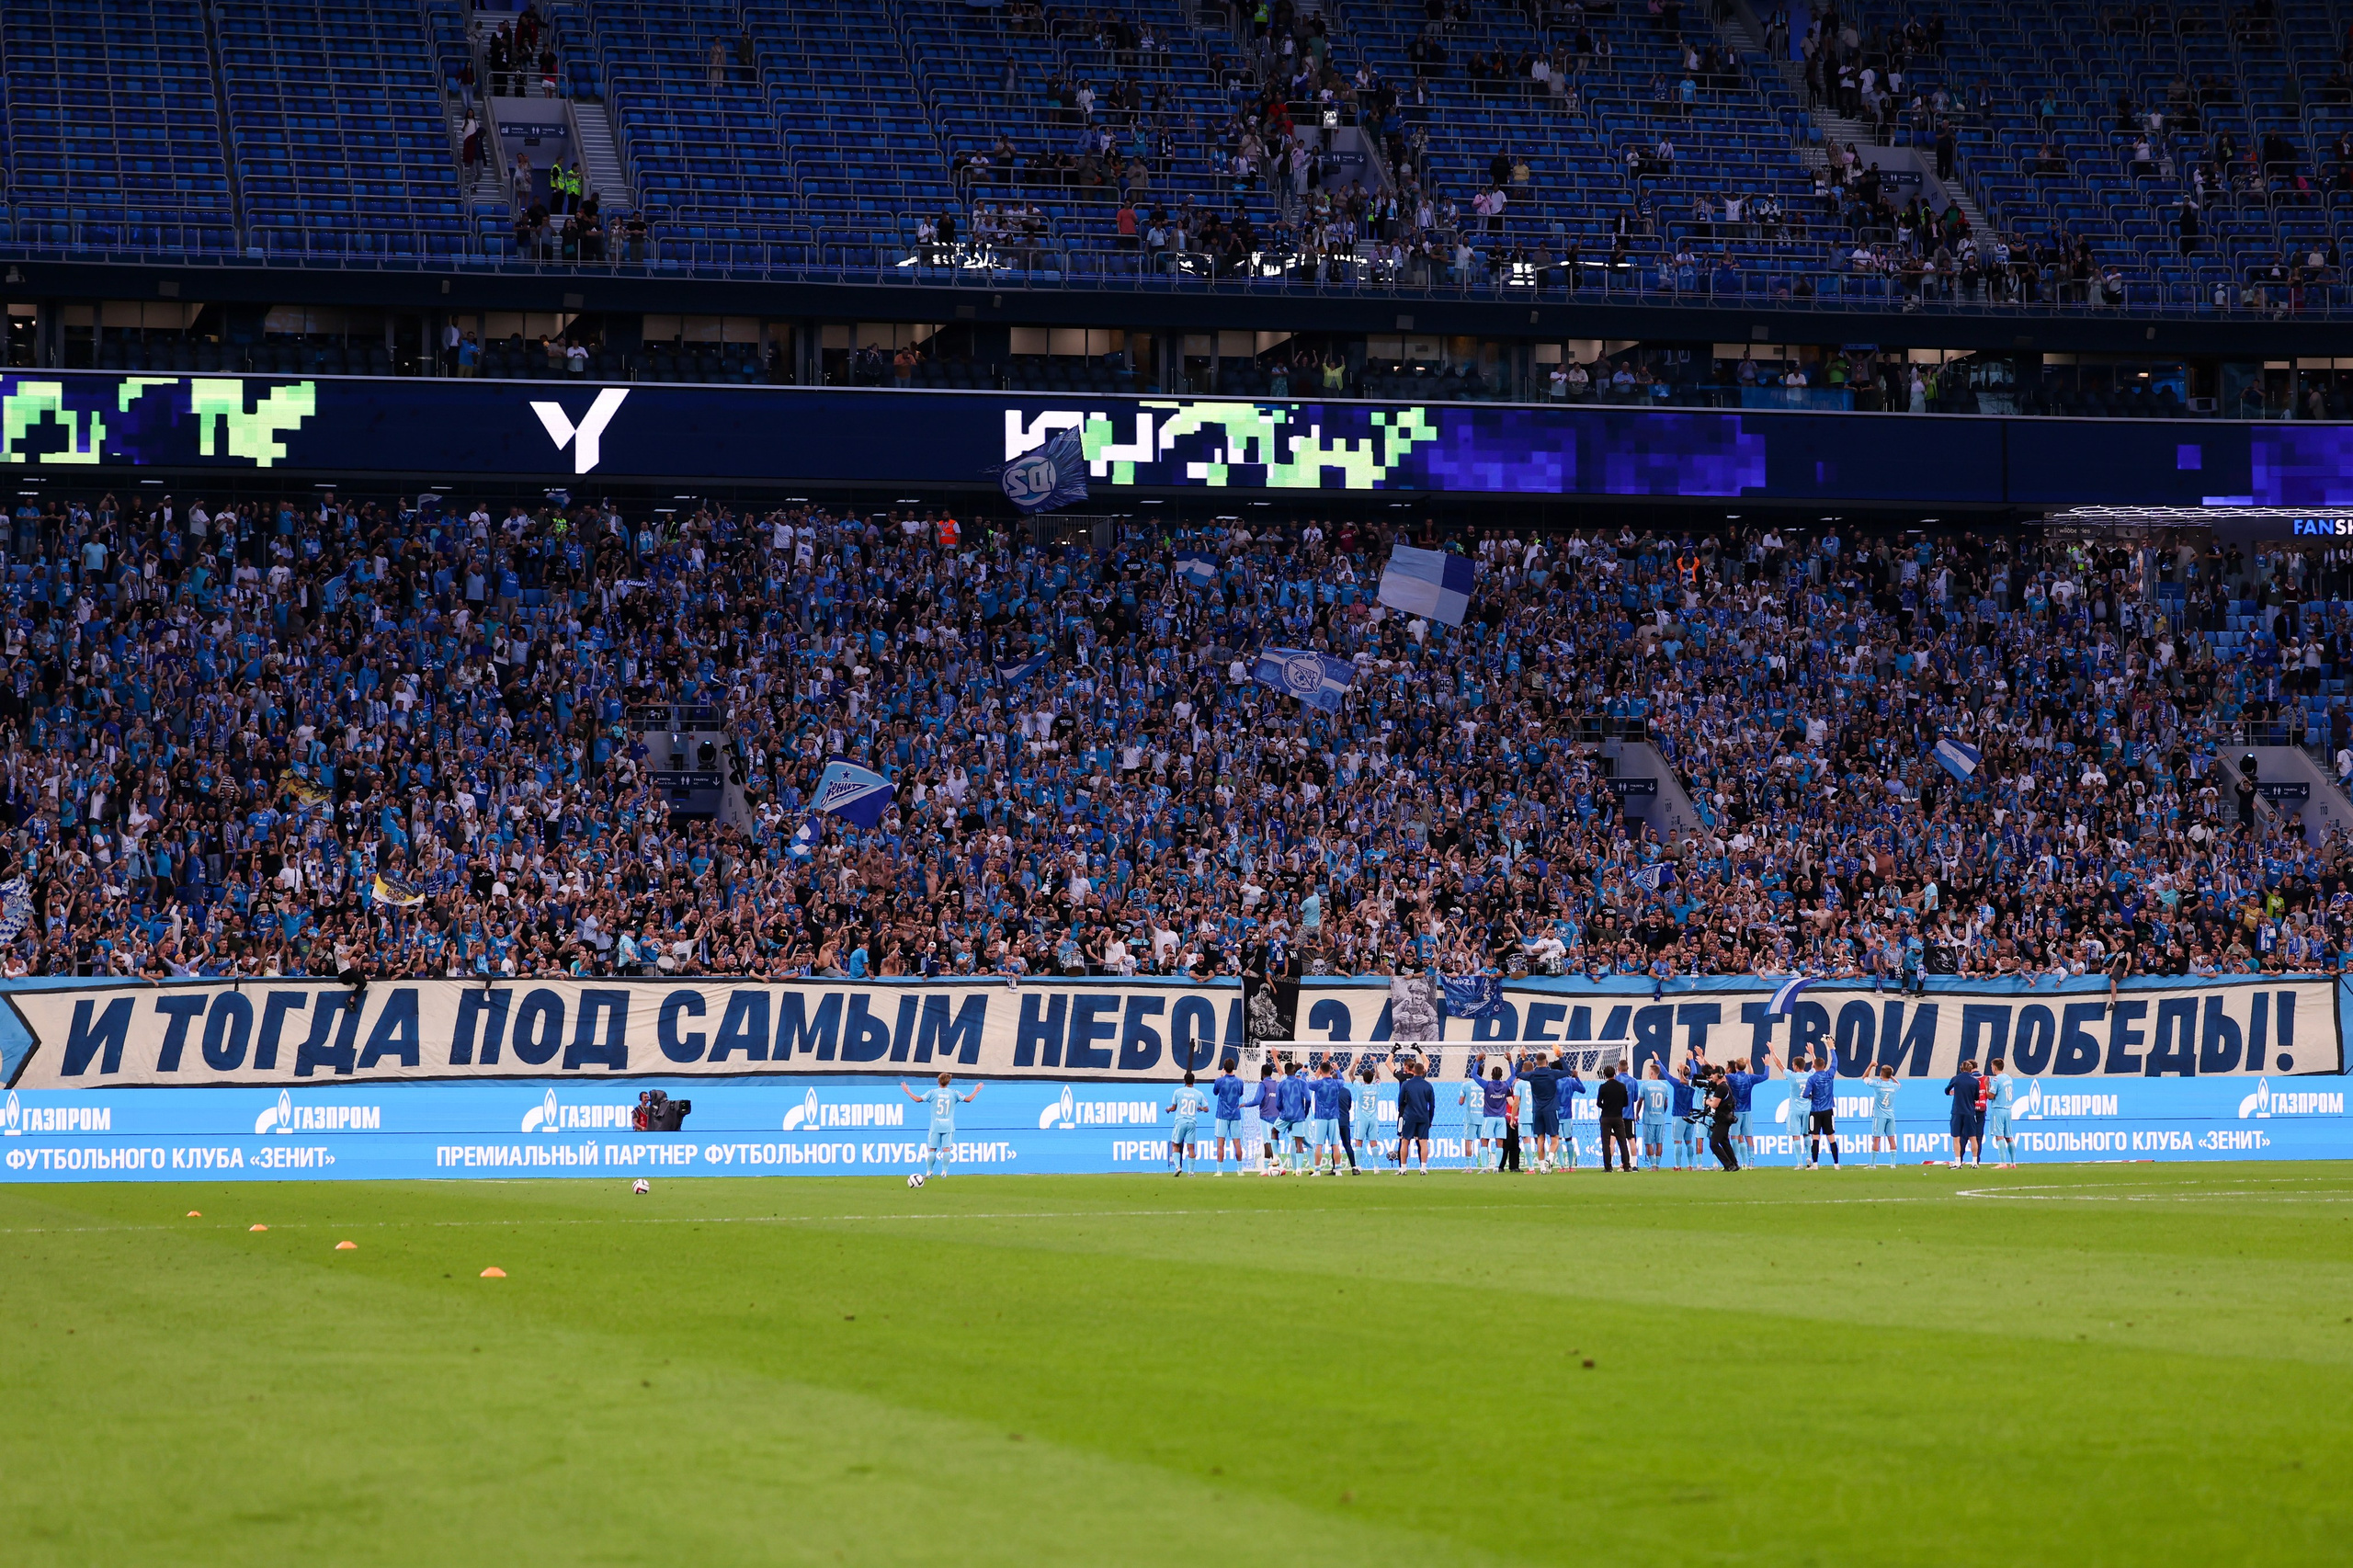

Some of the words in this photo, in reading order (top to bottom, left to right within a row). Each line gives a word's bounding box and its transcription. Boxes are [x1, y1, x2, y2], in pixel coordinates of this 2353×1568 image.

[2058, 527, 2091, 535] wildbeies
[61, 998, 131, 1076] И
[154, 988, 420, 1077] ТОГДА
[449, 988, 631, 1071] ПОД
[657, 990, 989, 1064] САМЫМ
[1740, 999, 1939, 1078] ТВОИ
[1958, 990, 2298, 1076] ПОБЕДЫ!
[1361, 1095, 1376, 1110] 31
[1470, 1091, 1485, 1108] 23
[1650, 1092, 1664, 1108] 10
[2005, 1085, 2013, 1102] 18
[2270, 1092, 2344, 1114] ГАЗПРОМ
[819, 1103, 904, 1126] ГАЗПРОМ
[936, 1098, 950, 1116] 51
[1075, 1101, 1157, 1125] ГАЗПРОМ
[1179, 1098, 1196, 1117] 20
[2042, 1094, 2118, 1116] ГАЗПРОМ
[22, 1108, 111, 1131] ГАЗПРОМ
[293, 1107, 381, 1130] ГАЗПРОМ
[1112, 1136, 1263, 1161] ПРЕМАЛН
[1753, 1133, 1898, 1154] ПРЕАЛЬНЫ
[1903, 1132, 1986, 1153] ПАРТ
[2132, 1131, 2194, 1151] КЛУБА
[2198, 1130, 2271, 1151] «ЗЕНИТ»
[6, 1146, 165, 1170] ФУТБОЛЬНОГО
[172, 1145, 244, 1168] КЛУБА
[249, 1144, 336, 1168] «ЗЕНИТ»
[436, 1141, 598, 1167] ПРЕМИАЛЬНЫЙ
[605, 1144, 698, 1165] ПАРТНЕР
[704, 1142, 858, 1165] ФУТБОЛЬНОГО
[861, 1142, 929, 1165] КЛУБА
[936, 1142, 1017, 1163] «ЗЕНИТ»
